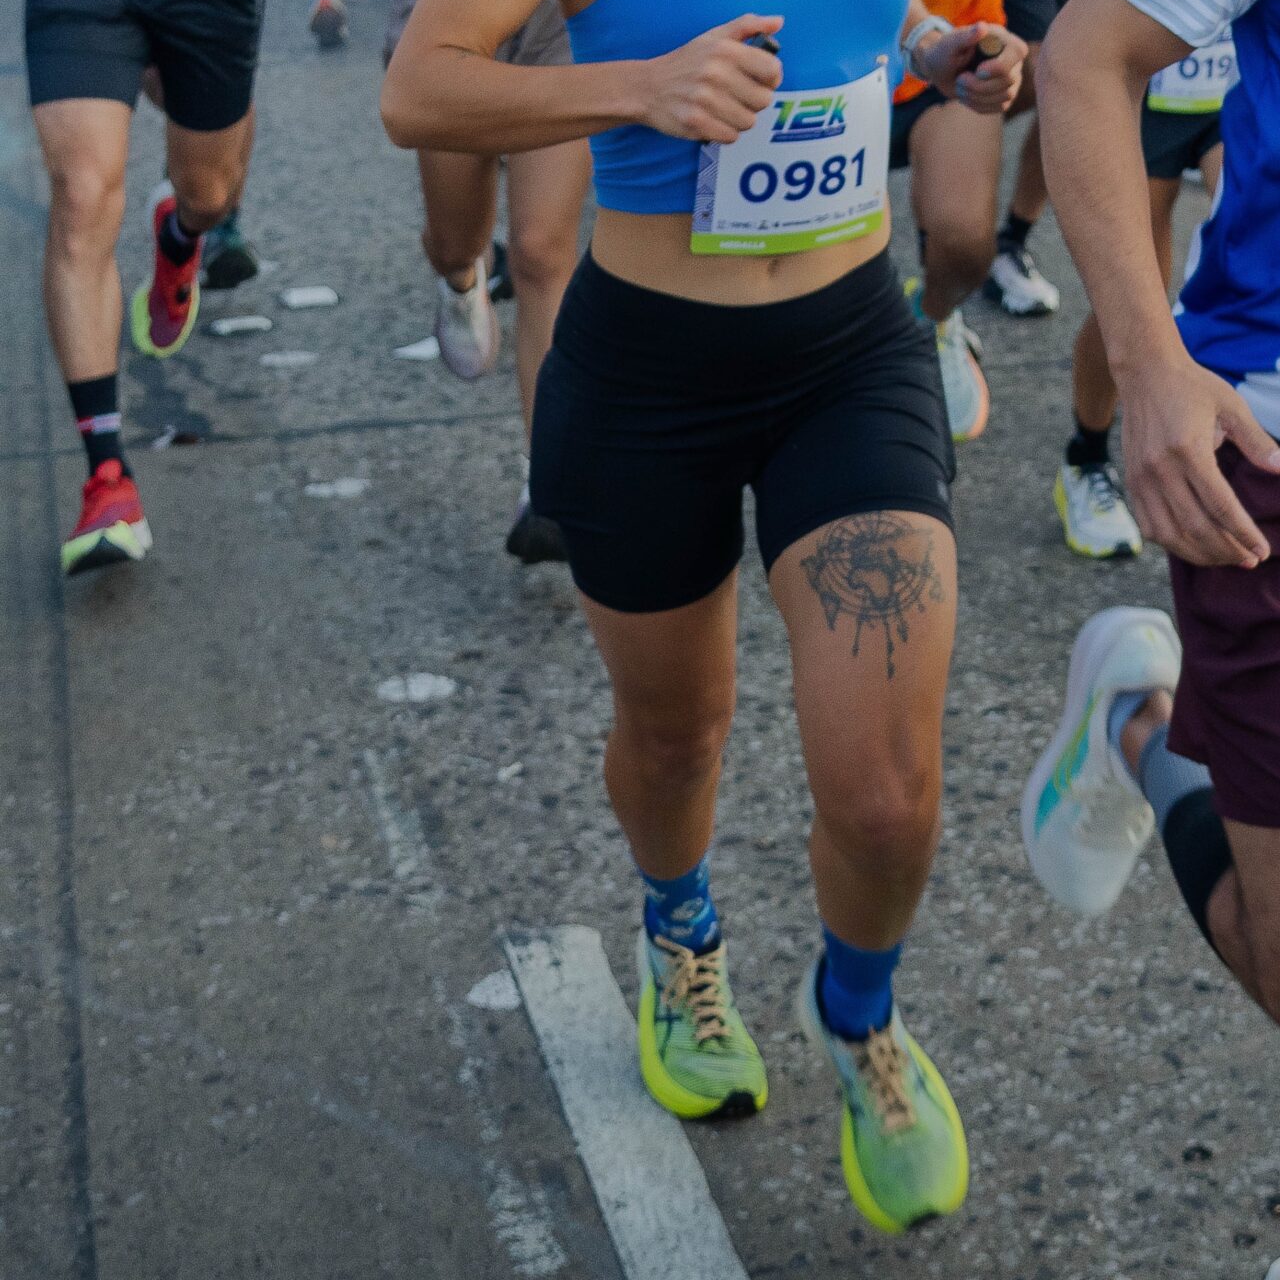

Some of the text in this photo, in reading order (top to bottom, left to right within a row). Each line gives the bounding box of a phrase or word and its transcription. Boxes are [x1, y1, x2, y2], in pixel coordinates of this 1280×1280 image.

[1178, 55, 1233, 79] 019
[771, 95, 849, 131] 12k
[739, 147, 866, 204] 0981
